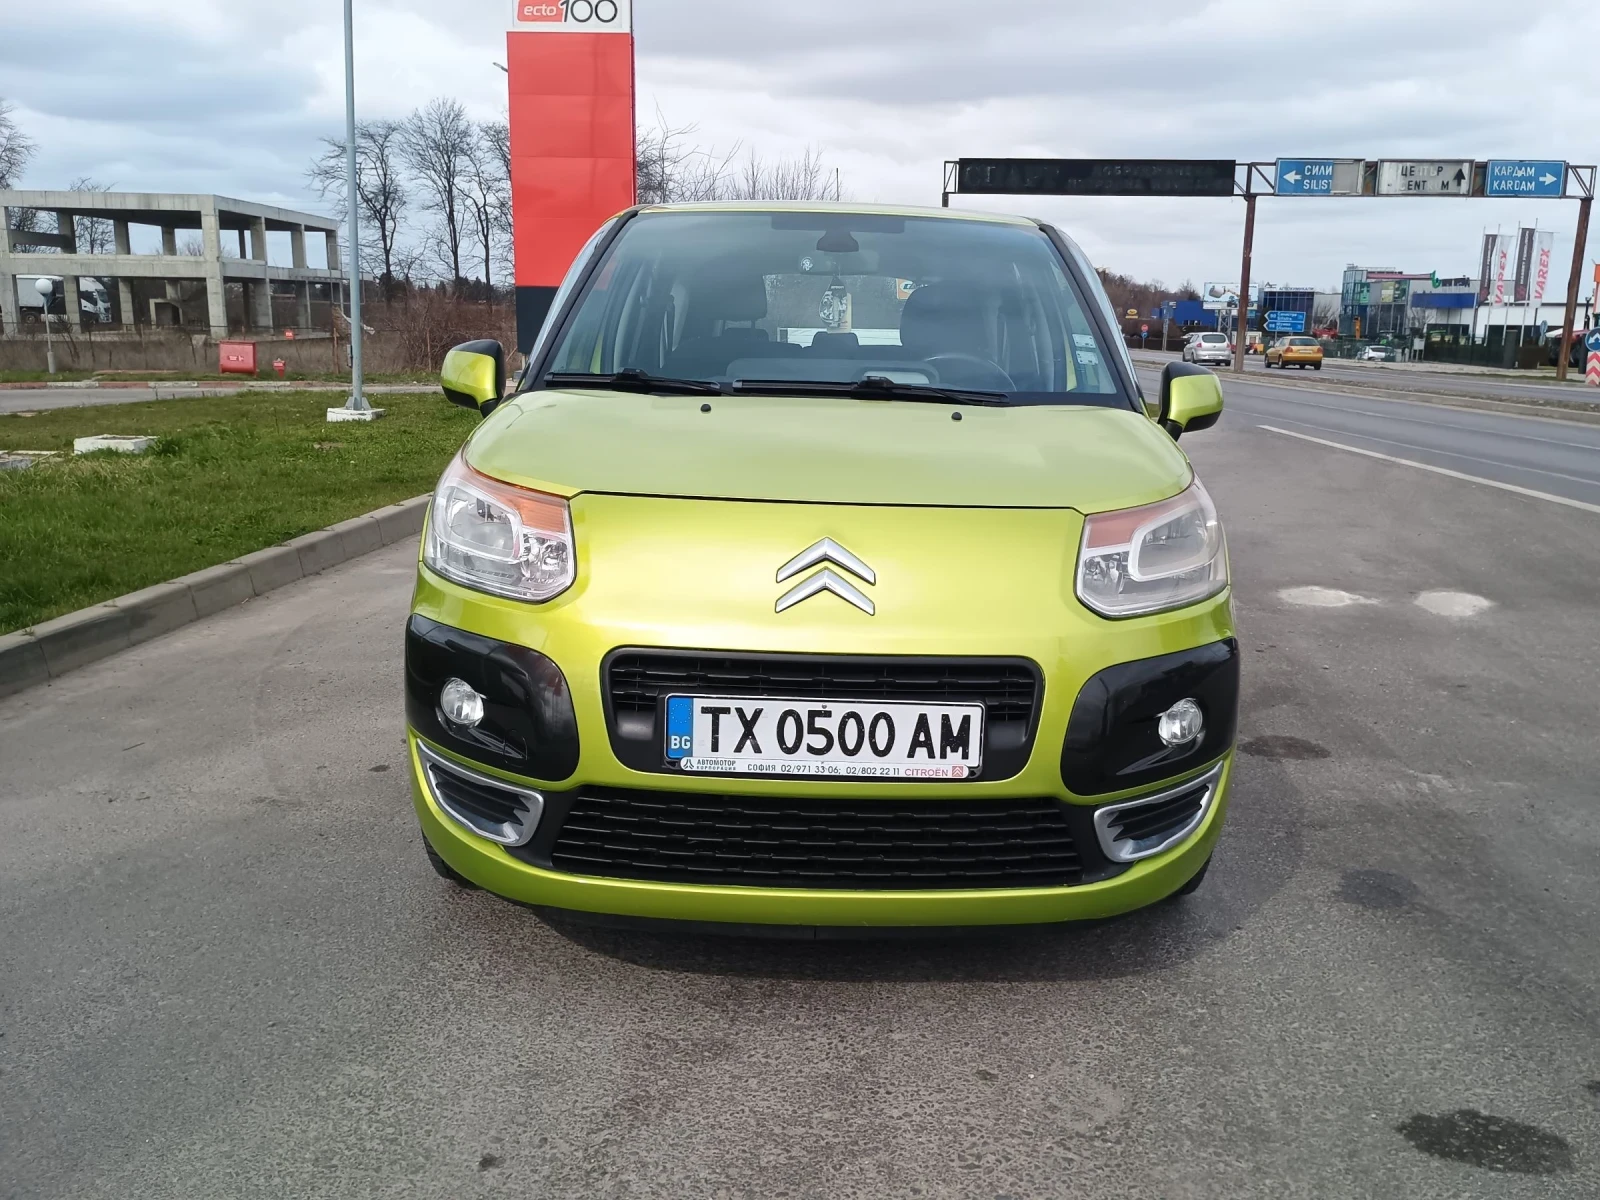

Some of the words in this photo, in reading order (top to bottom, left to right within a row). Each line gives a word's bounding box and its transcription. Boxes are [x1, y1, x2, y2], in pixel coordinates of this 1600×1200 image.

[1494, 166, 1535, 177] КАРДАМ
[1493, 180, 1535, 191] KARDAM
[1534, 247, 1550, 299] VAREX
[701, 706, 764, 754] TX
[776, 708, 896, 758] 0500
[907, 713, 971, 760] AM
[670, 735, 691, 749] BG
[747, 764, 776, 772] СОФИЯ
[781, 764, 811, 774] 02/971
[846, 766, 877, 776] 02/802
[880, 768, 890, 776] 22
[893, 768, 900, 776] 11
[904, 767, 949, 777] CITROËN
